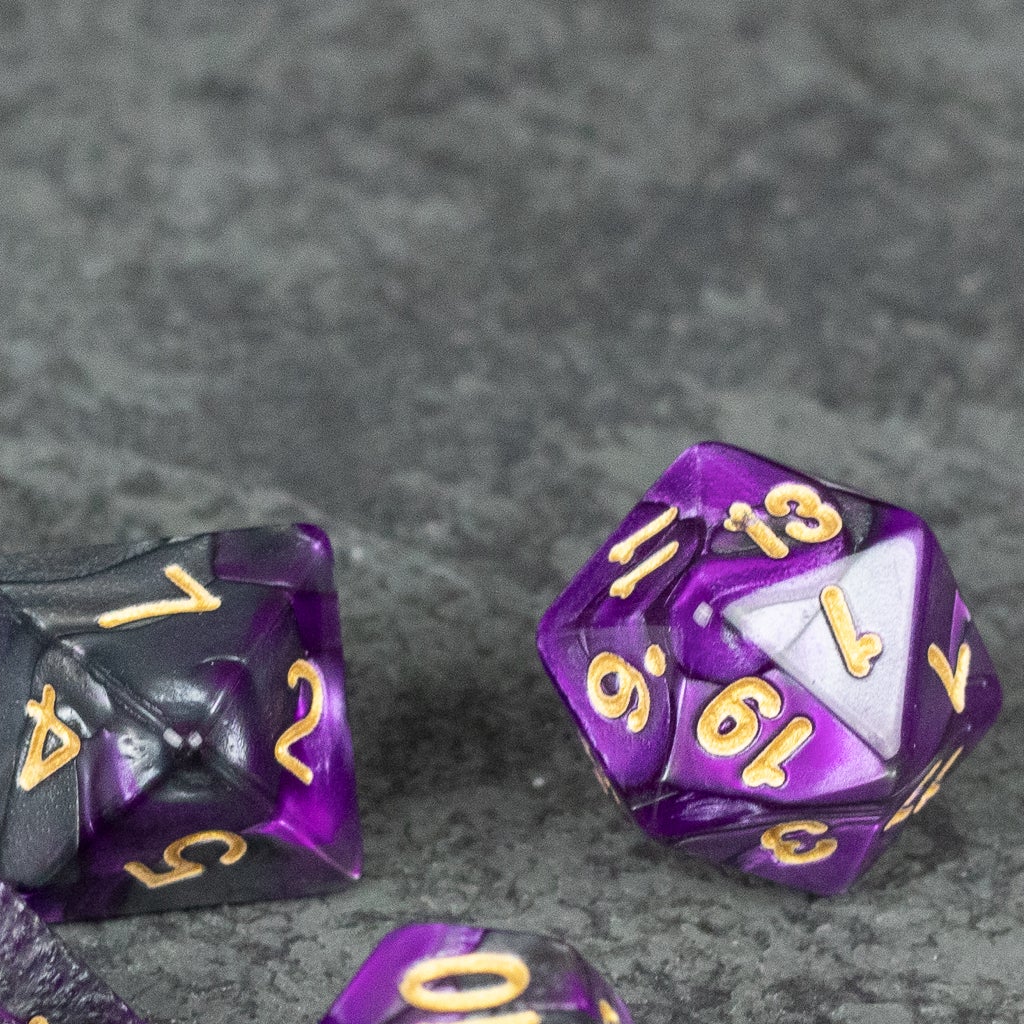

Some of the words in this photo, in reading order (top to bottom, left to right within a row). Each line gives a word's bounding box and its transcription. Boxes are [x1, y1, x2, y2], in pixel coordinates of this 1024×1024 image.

[608, 506, 679, 600] 11
[724, 481, 843, 559] 13
[820, 585, 883, 678] 1
[926, 641, 972, 714] 7
[19, 684, 82, 791] 4
[274, 658, 323, 785] 2
[696, 676, 814, 788] 19
[124, 829, 248, 888] 5
[760, 820, 838, 864] 3
